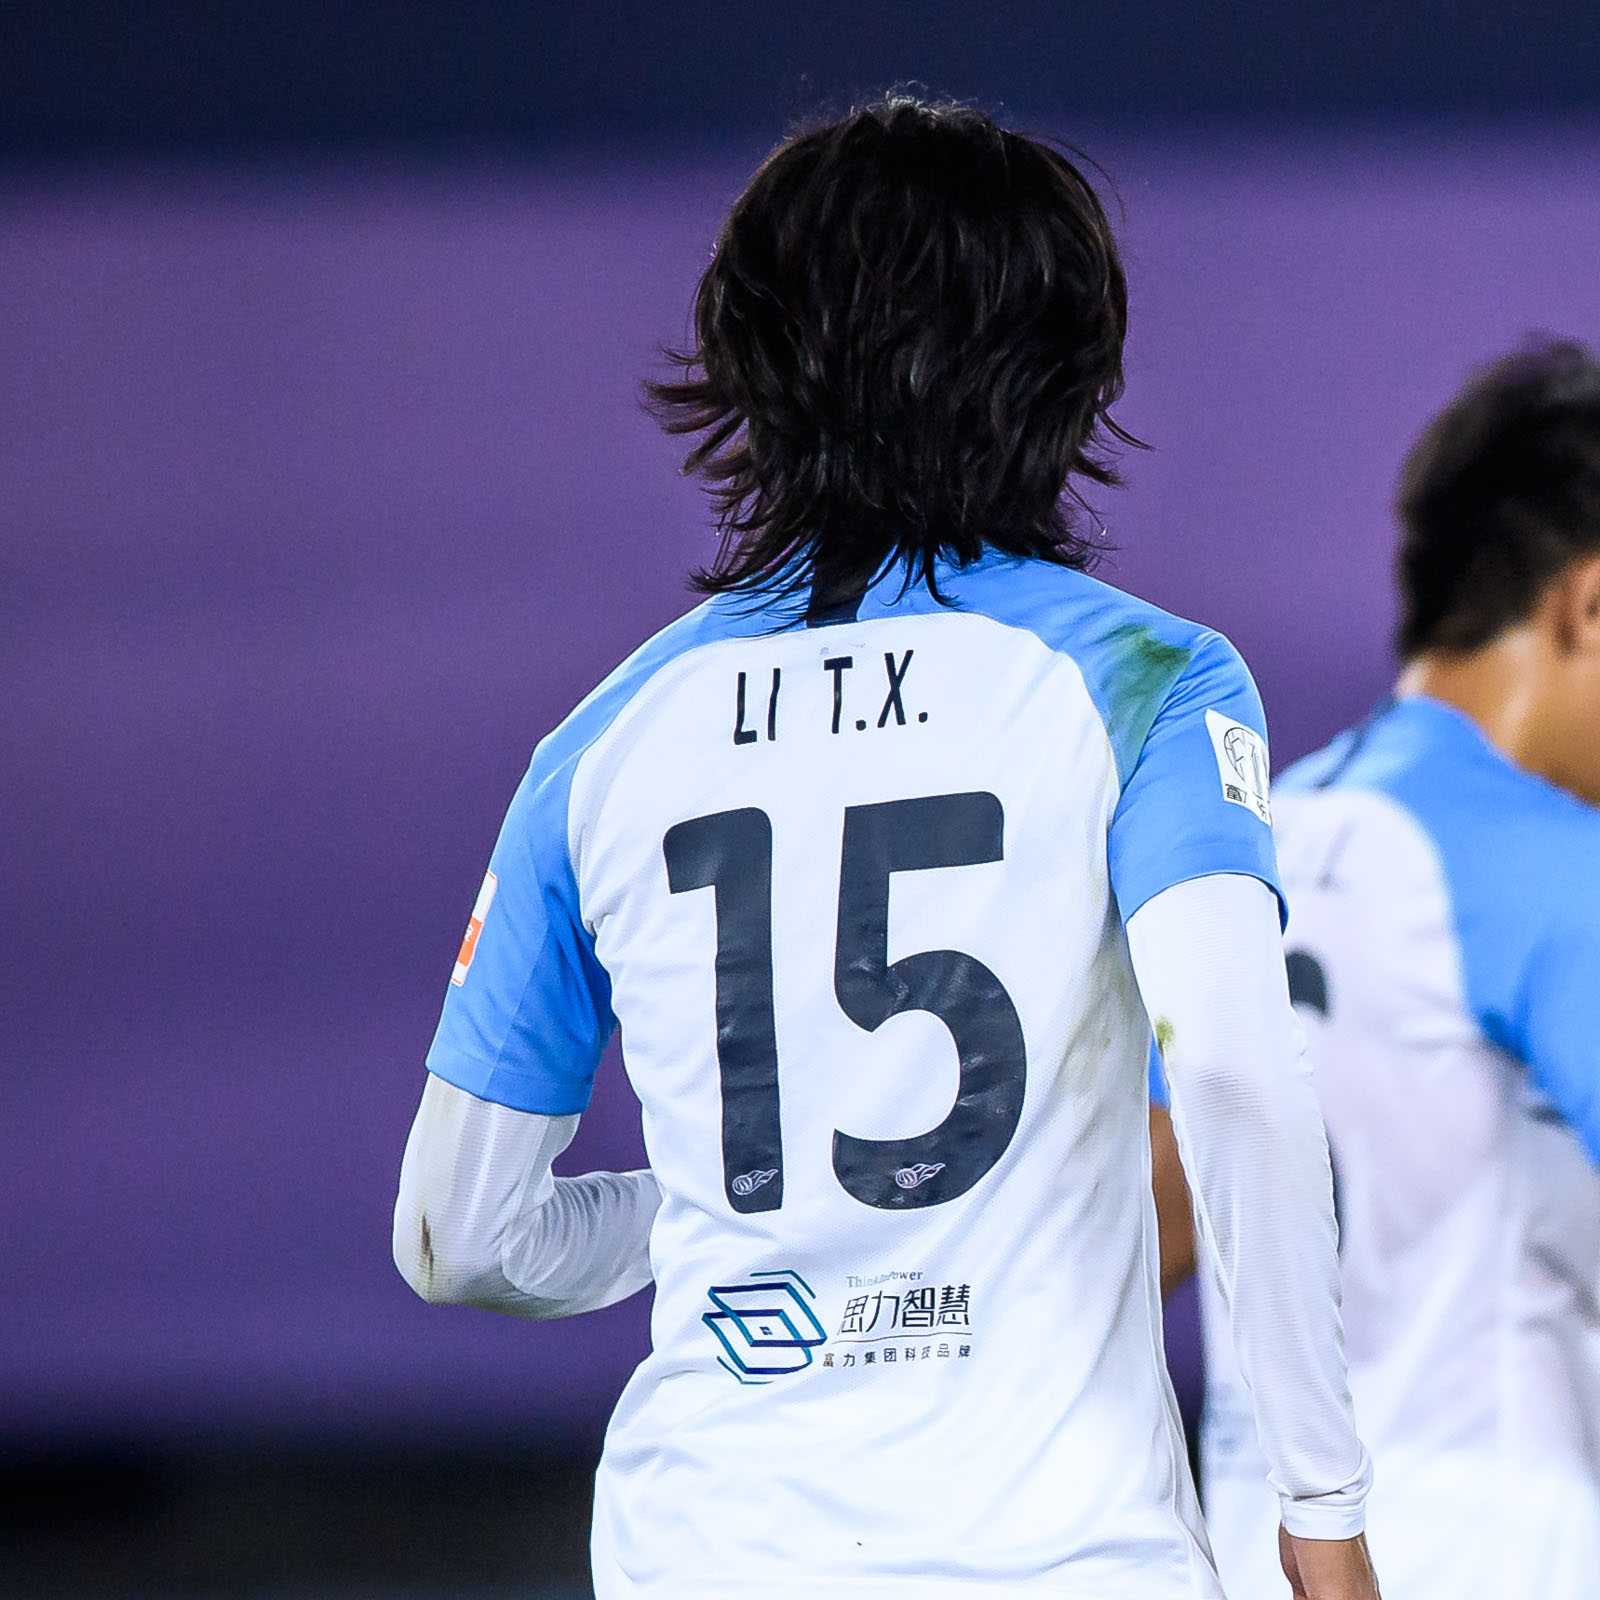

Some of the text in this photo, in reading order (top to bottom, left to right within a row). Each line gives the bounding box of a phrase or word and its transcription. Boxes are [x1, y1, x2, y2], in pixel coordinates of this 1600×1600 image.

[734, 649, 928, 745] LI T.X.
[663, 791, 1027, 1215] 15
